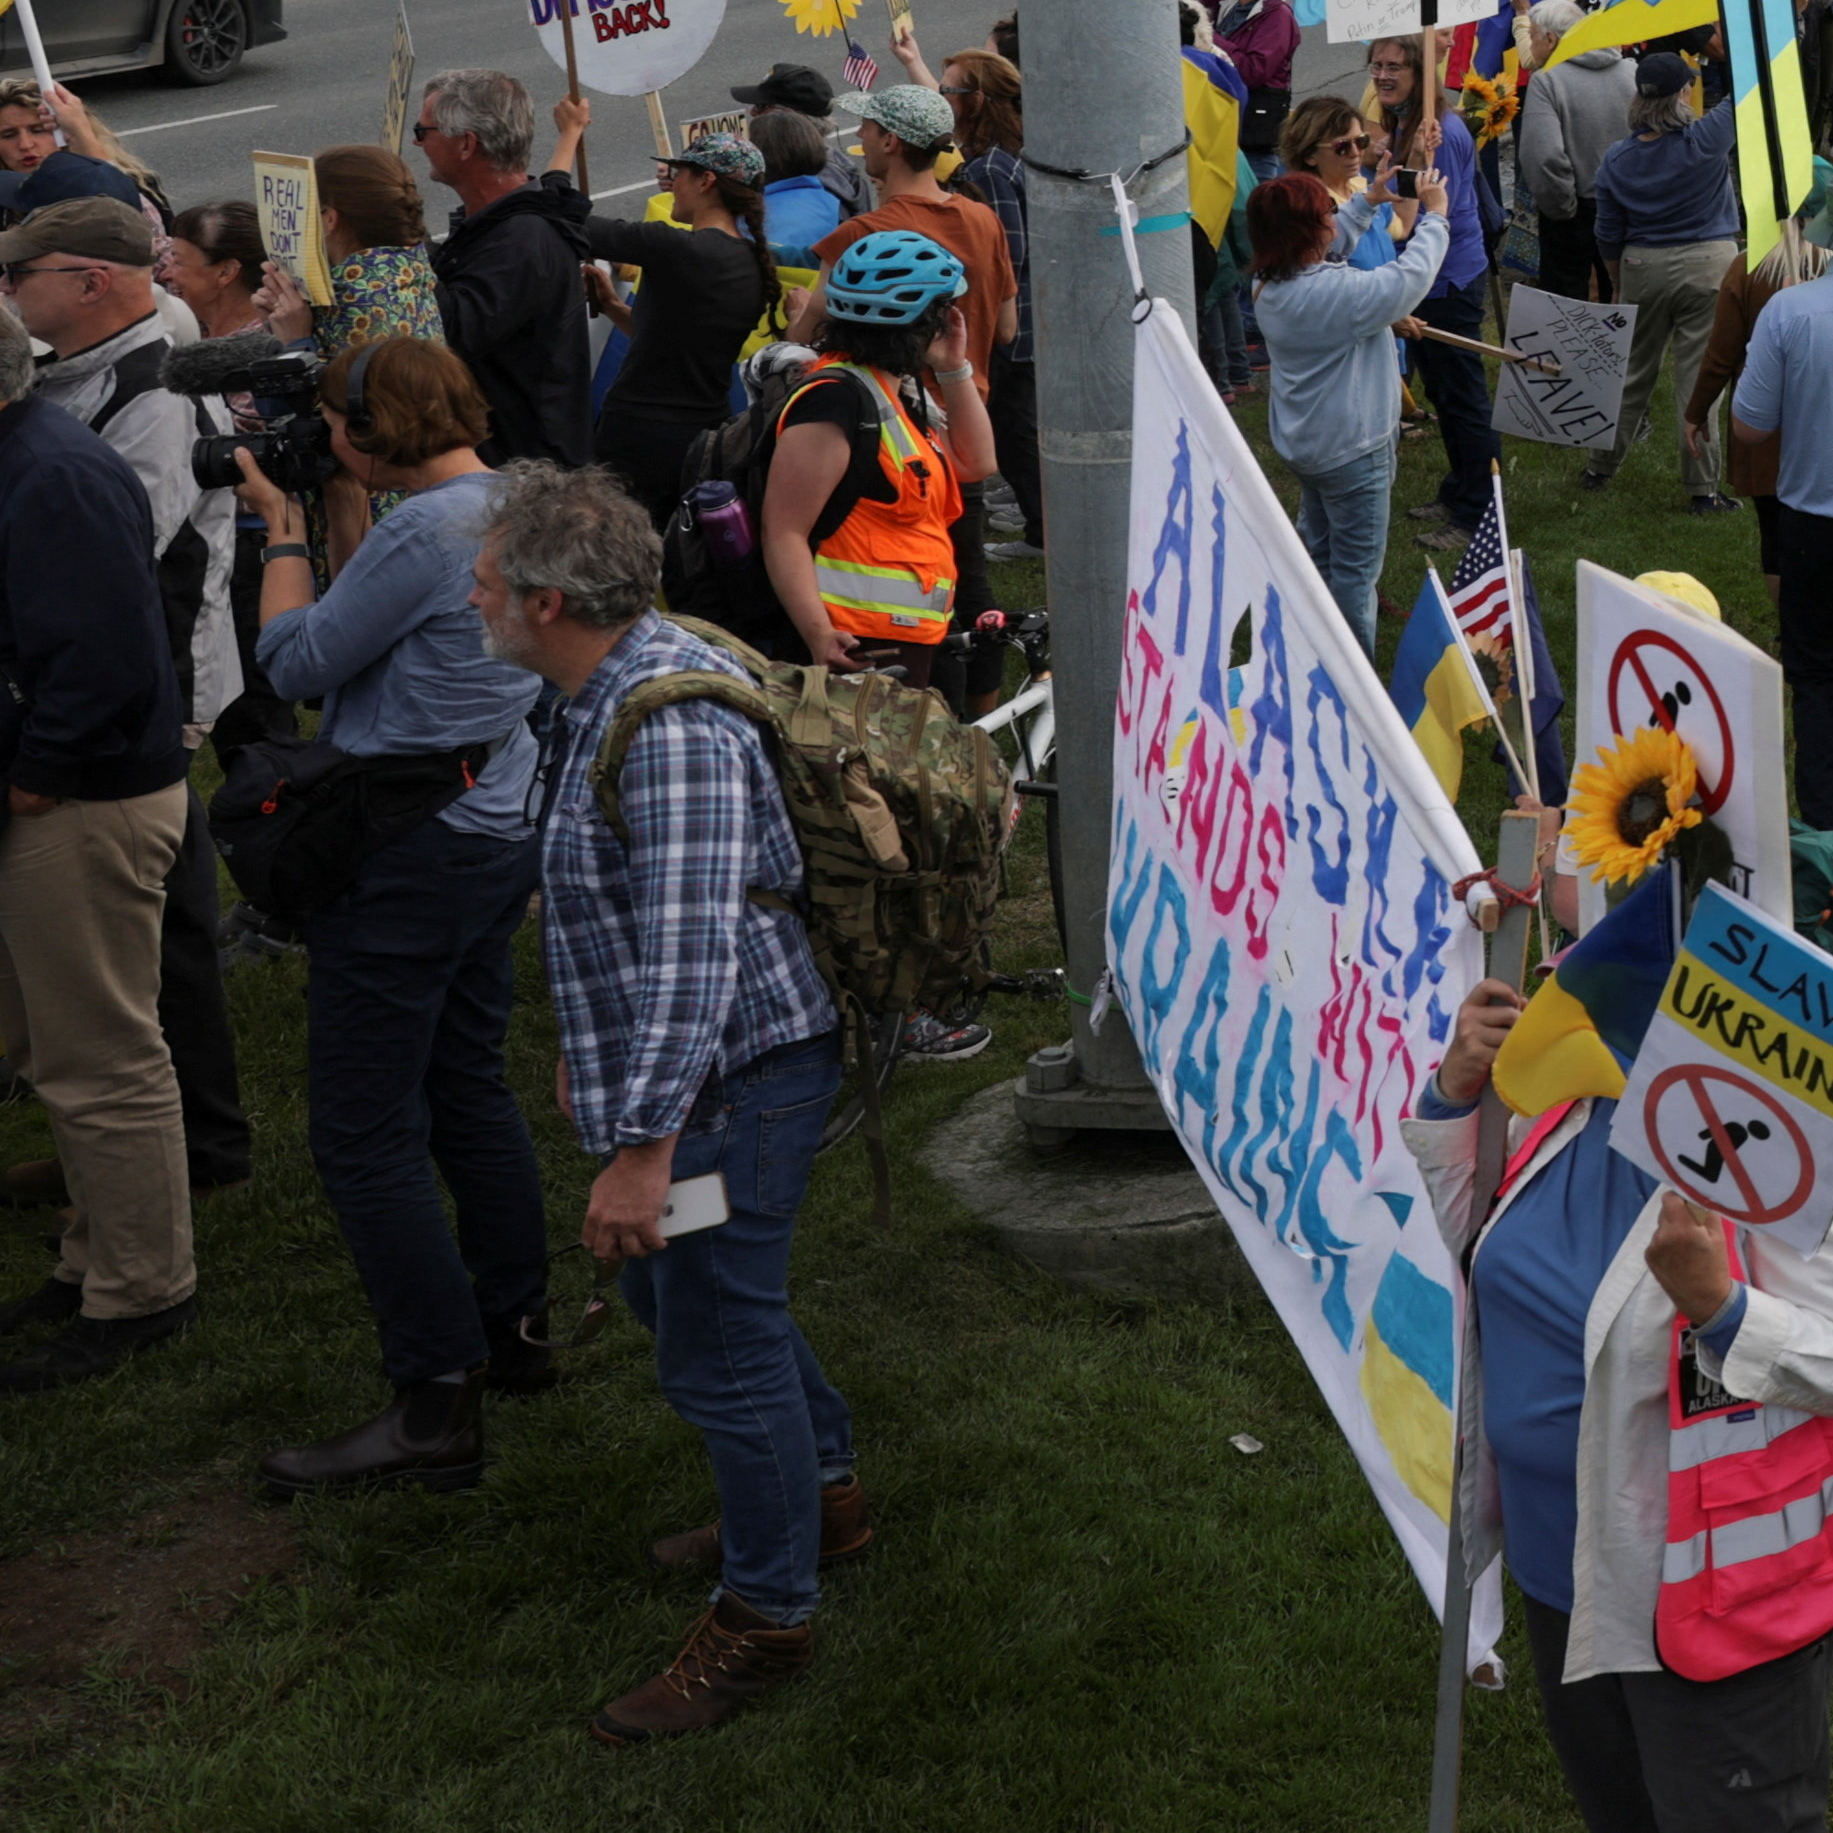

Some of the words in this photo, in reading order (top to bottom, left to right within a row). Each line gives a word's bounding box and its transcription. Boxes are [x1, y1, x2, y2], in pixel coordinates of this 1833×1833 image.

[263, 175, 304, 210] REAL
[271, 209, 297, 231] MEN
[270, 231, 301, 254] DONT
[1606, 311, 1628, 329] NO
[1510, 331, 1615, 445] LEAVE!
